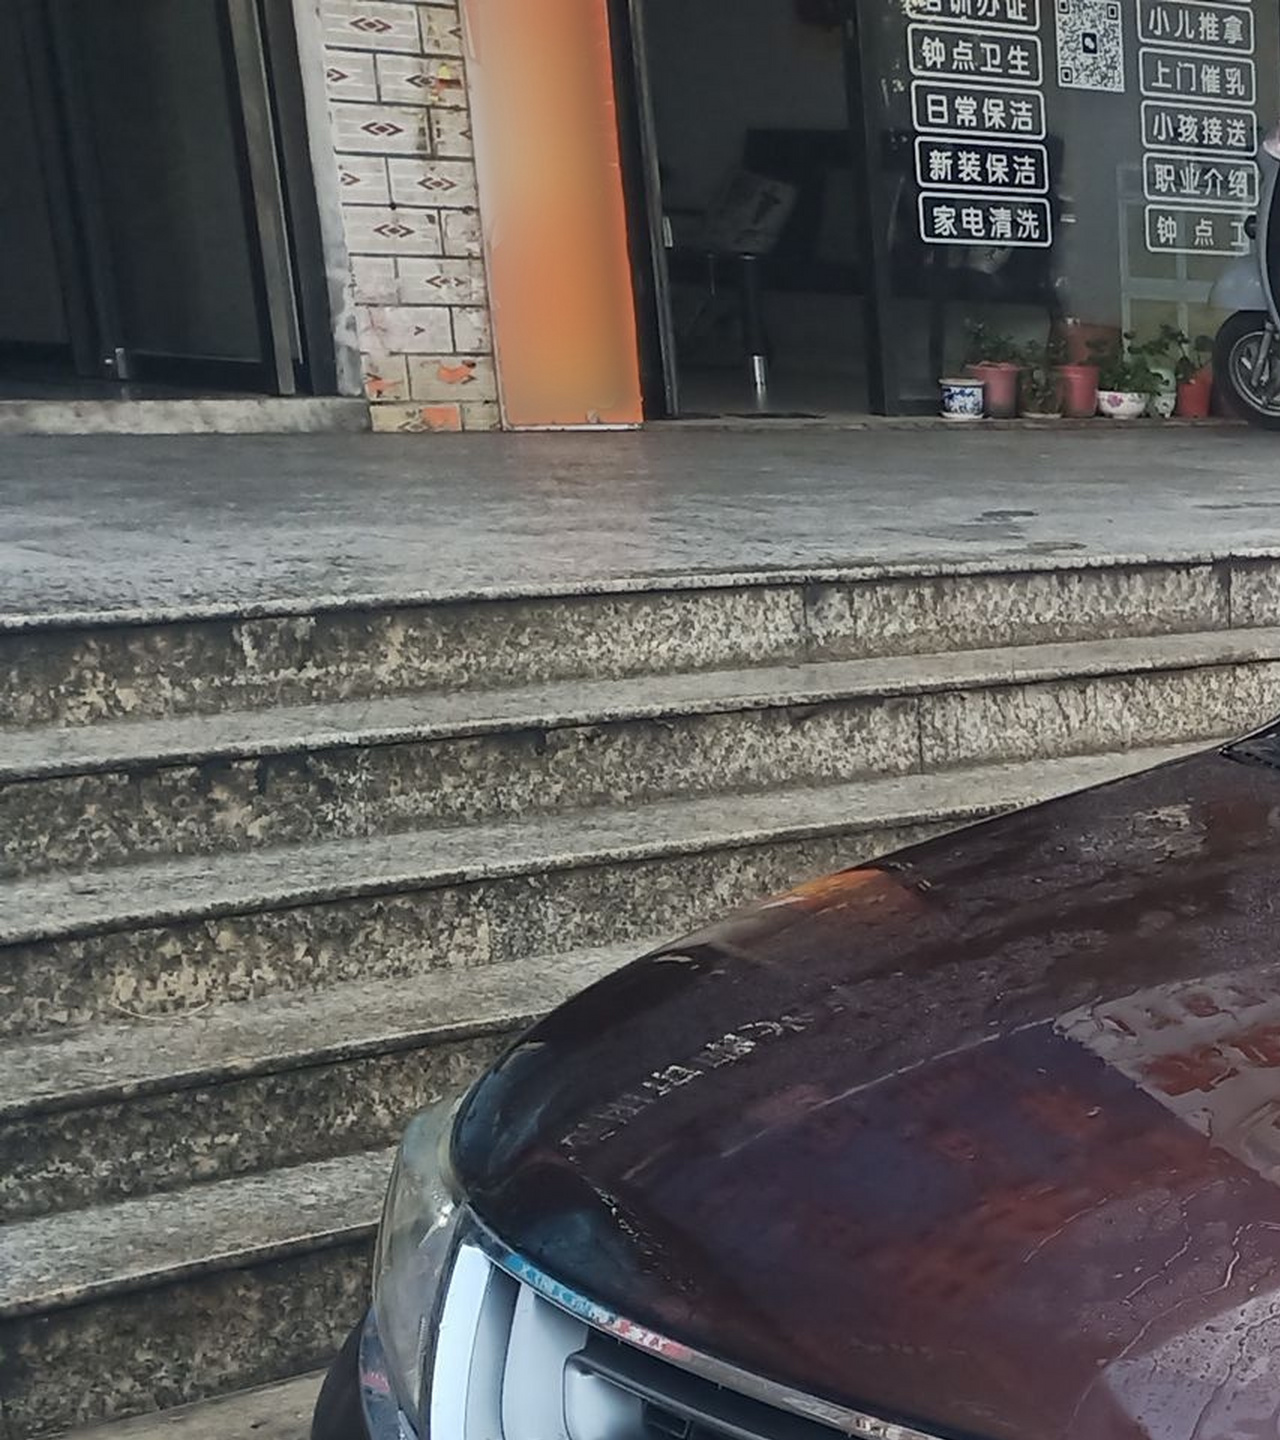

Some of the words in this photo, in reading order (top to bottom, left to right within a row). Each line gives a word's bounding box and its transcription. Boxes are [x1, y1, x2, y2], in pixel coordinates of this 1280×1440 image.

[1149, 6, 1243, 44] 小儿推拿
[921, 36, 1030, 75] 钟点卫生
[1151, 60, 1245, 95] 上门催乳
[926, 94, 1033, 131] 日常保洁
[1153, 112, 1247, 147] 小孩接送
[929, 149, 1036, 185] 新装保洁
[1154, 163, 1248, 197] 职业介绍
[932, 205, 1040, 239] 家电清洗
[1157, 215, 1245, 246] 钟点工
